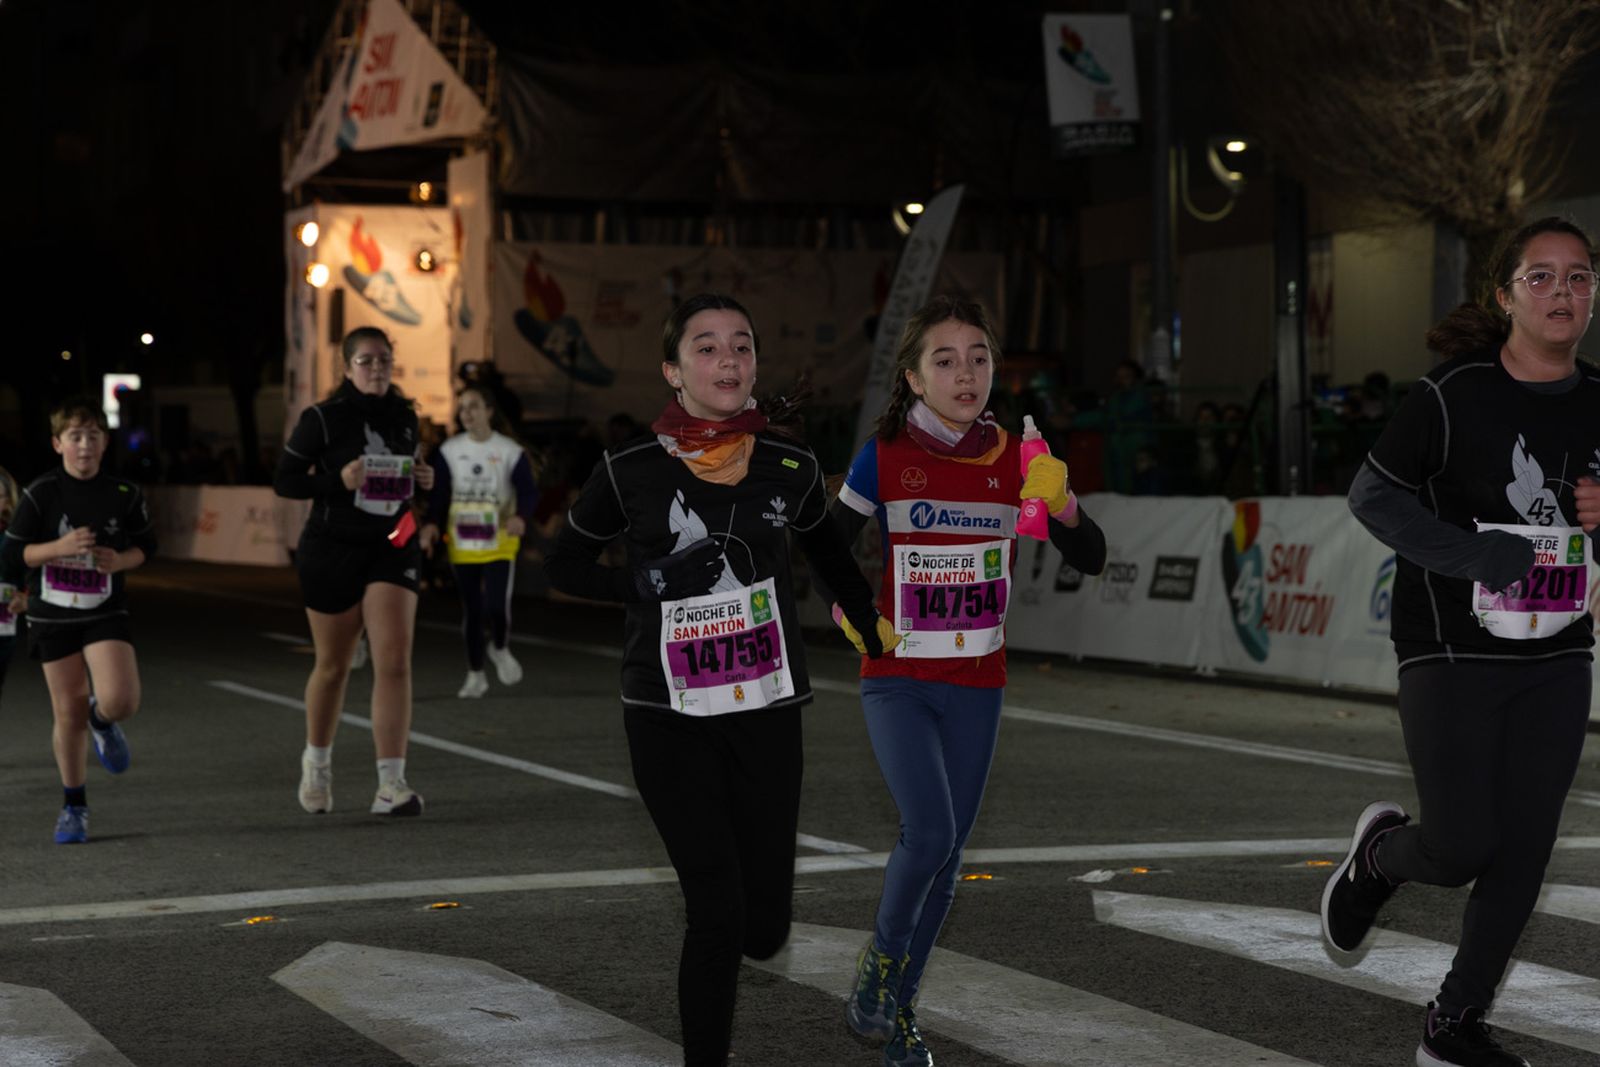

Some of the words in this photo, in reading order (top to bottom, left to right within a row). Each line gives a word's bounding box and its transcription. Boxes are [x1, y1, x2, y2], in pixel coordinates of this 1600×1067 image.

[937, 509, 1001, 529] Avanza
[1527, 498, 1556, 526] 43
[1545, 540, 1559, 550] DE
[922, 558, 959, 569] NOCHE
[962, 557, 975, 568] DE
[1266, 544, 1313, 584] SAN
[1535, 550, 1557, 564] TÓN
[909, 571, 932, 583] SAN
[935, 568, 976, 583] ANTÓN
[914, 583, 998, 618] 14754
[1257, 582, 1334, 636] ANTÓN
[687, 607, 725, 623] NOCHE
[728, 603, 743, 616] DE
[674, 626, 699, 640] SAN
[702, 617, 745, 637] ANTÓN
[680, 627, 772, 676] 14755
